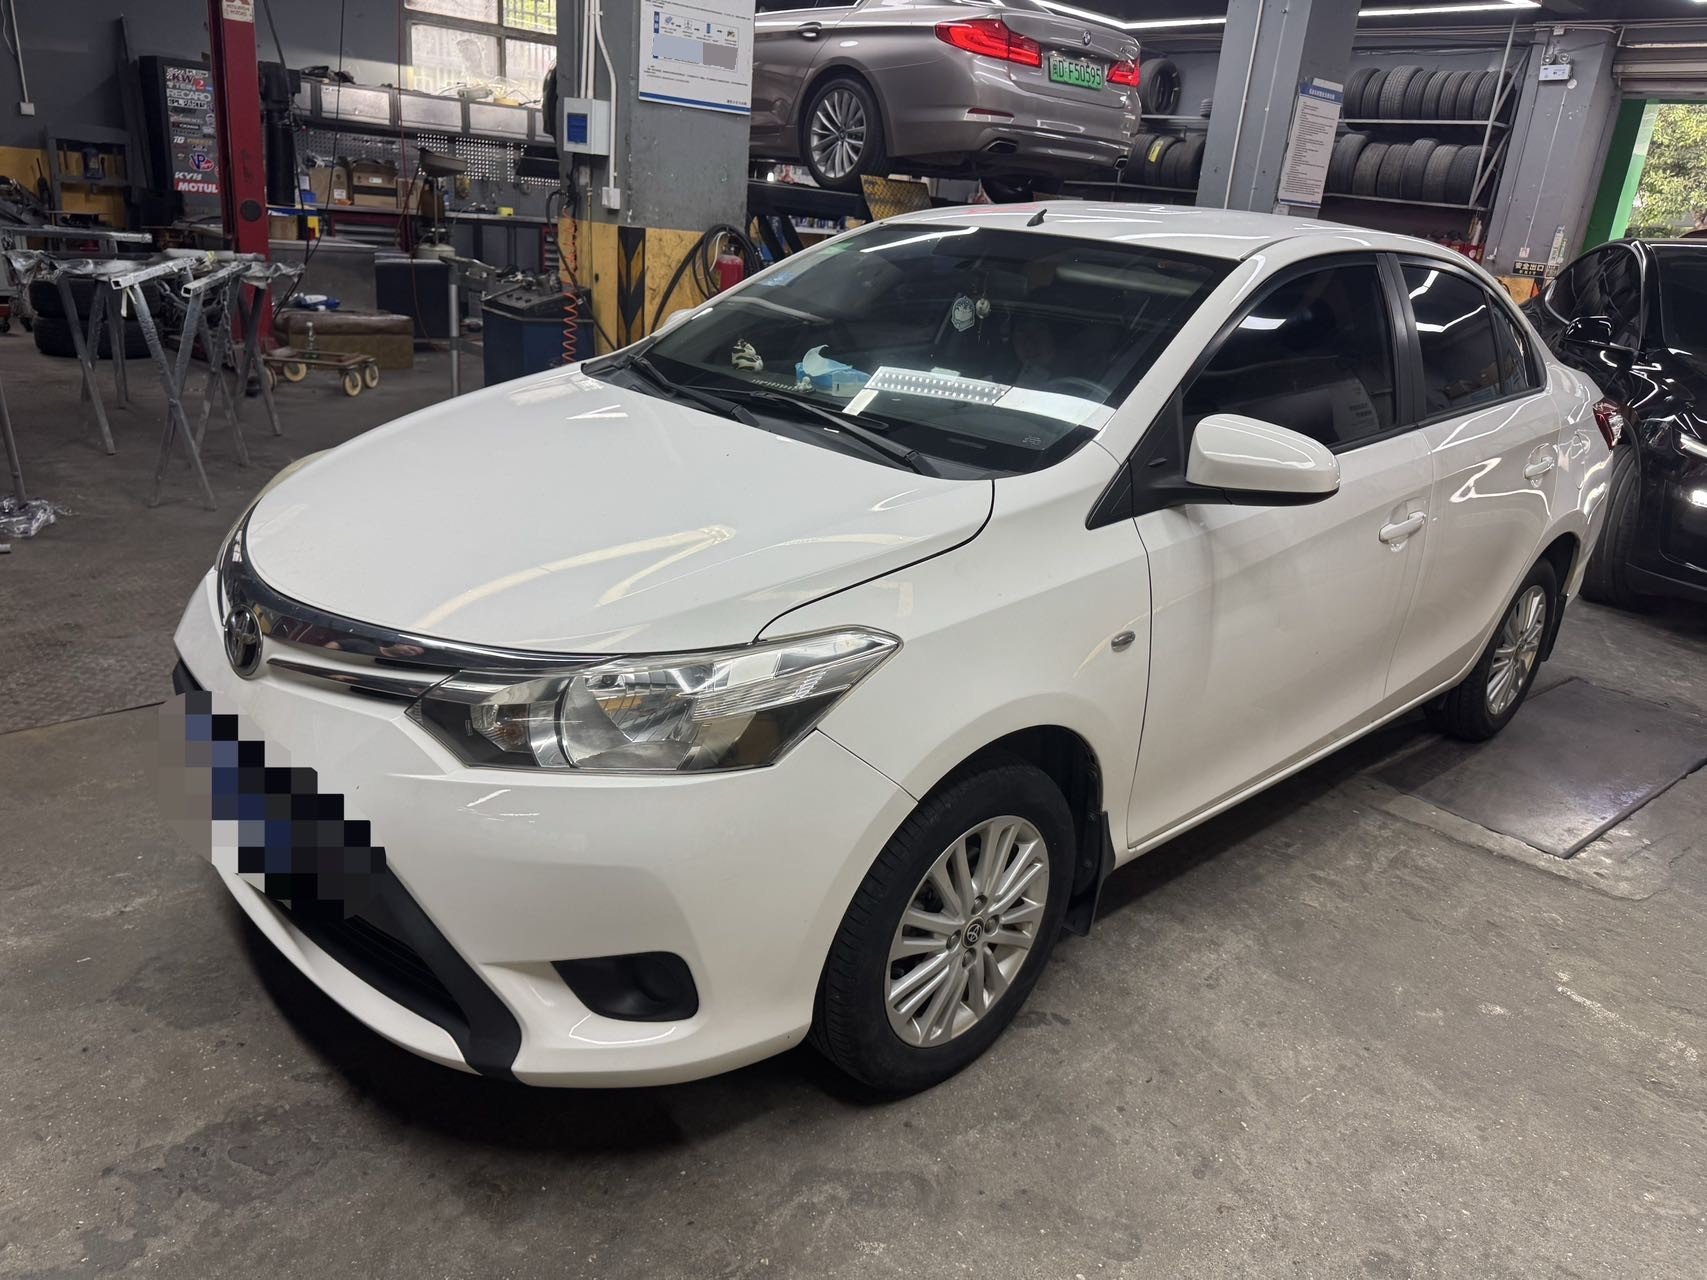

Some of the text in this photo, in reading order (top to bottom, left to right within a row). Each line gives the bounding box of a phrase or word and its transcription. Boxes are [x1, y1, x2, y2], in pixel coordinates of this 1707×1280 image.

[167, 89, 211, 102] RECARO
[177, 181, 218, 193] MOTUL
[1515, 262, 1545, 272] 安全出口
